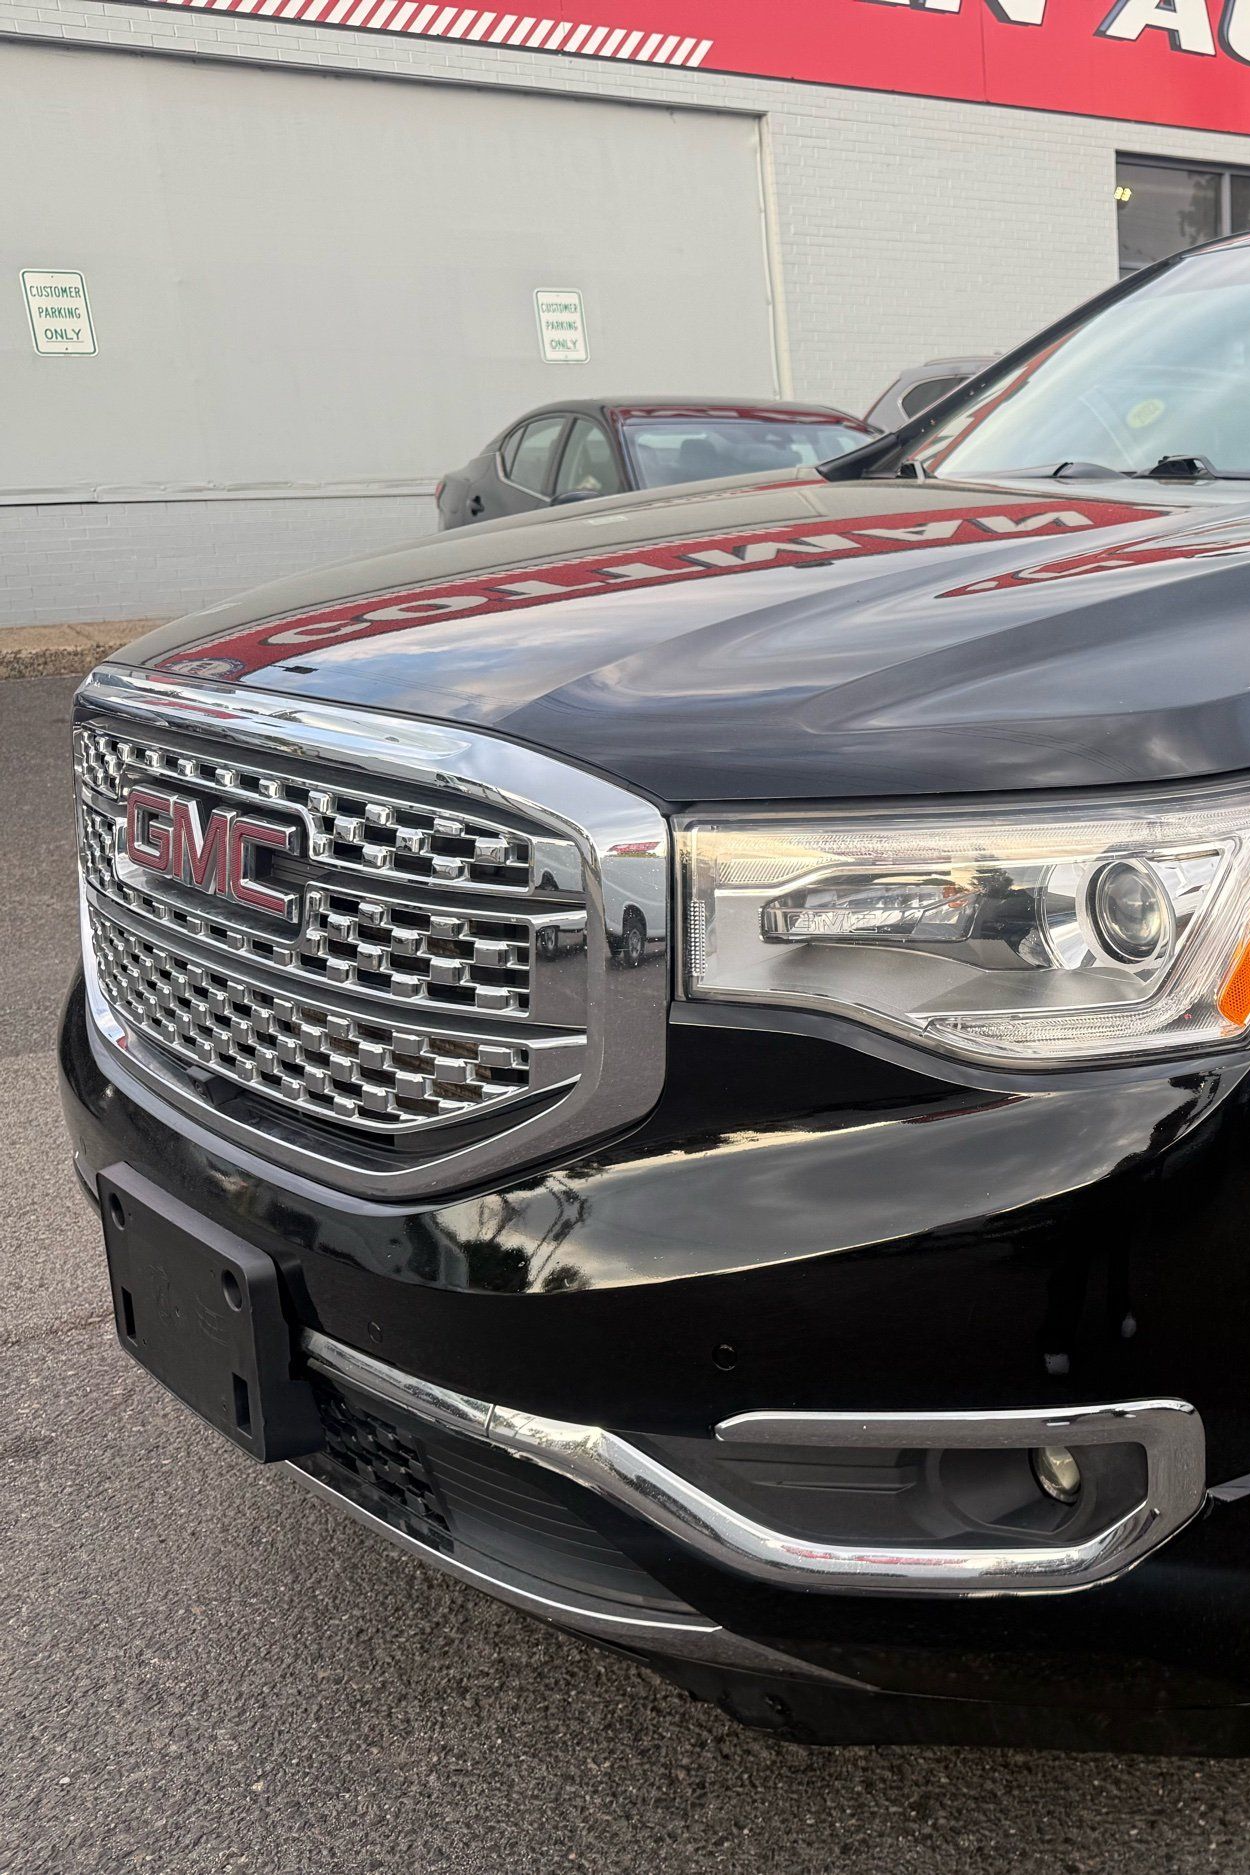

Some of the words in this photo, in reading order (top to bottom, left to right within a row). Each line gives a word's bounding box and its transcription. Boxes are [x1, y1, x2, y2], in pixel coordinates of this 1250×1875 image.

[29, 285, 81, 298] CUSTOMER
[37, 306, 81, 319] PARKING
[540, 302, 577, 313] CUSTOMER
[545, 320, 577, 331] PARKING
[44, 328, 81, 341] ONLY
[550, 339, 577, 350] ONLY
[127, 784, 300, 922] GMC
